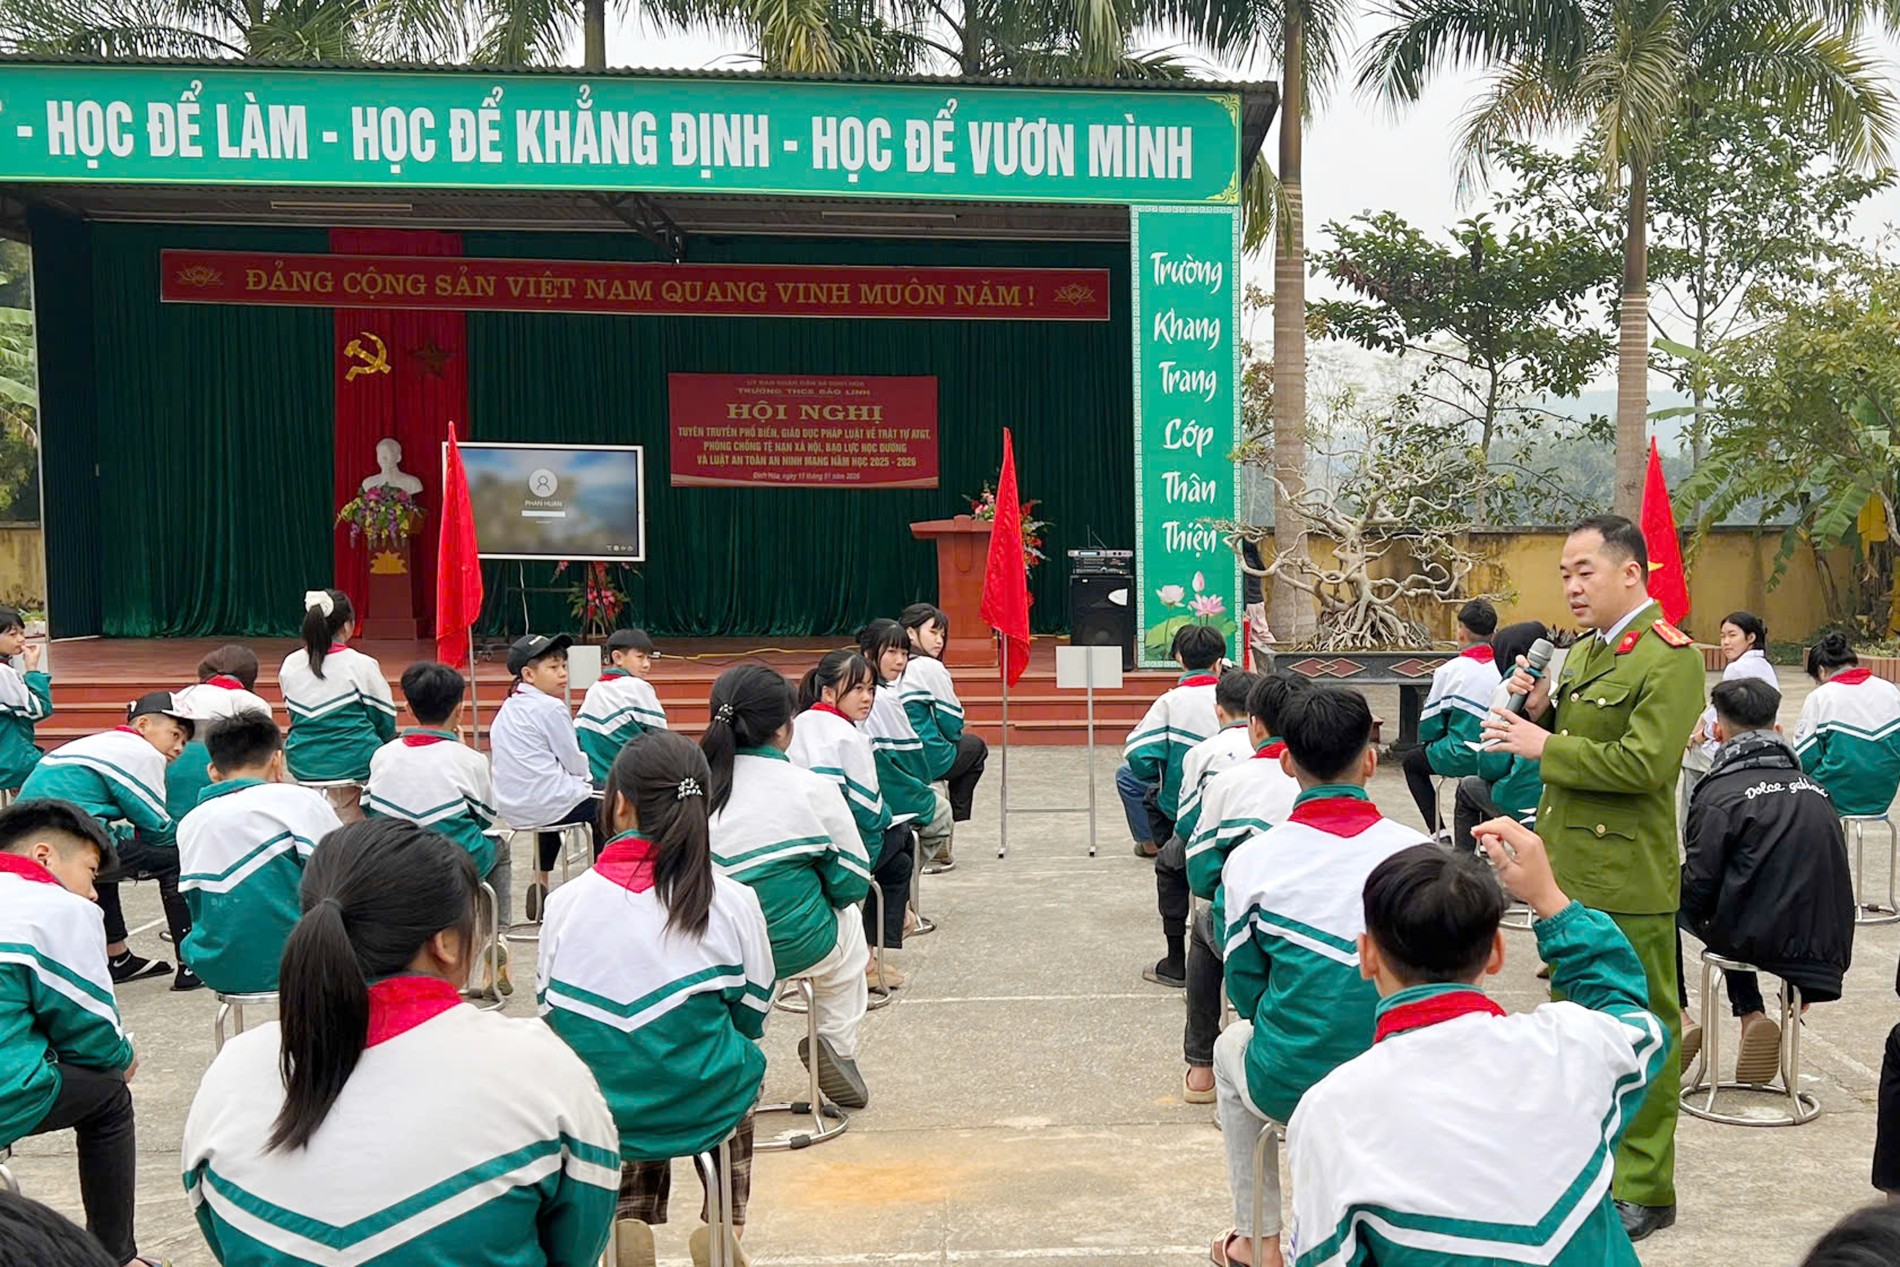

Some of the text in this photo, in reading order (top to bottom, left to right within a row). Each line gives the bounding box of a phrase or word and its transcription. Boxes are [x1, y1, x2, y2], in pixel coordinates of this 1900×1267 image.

[46, 100, 134, 168] HỌC
[147, 79, 203, 158] ĐỂ
[216, 92, 308, 160] LÀM
[351, 105, 436, 174] HỌC
[449, 86, 504, 162] ĐỂ
[516, 84, 658, 165] KHẲNG
[670, 111, 770, 178] ĐỊNH
[811, 116, 892, 182] HỌC
[904, 98, 956, 173] ĐỂ
[968, 117, 1075, 177] VƯƠN
[1088, 113, 1193, 179] MÌNH
[246, 260, 334, 293] ĐẢNG
[342, 266, 427, 299] CỘNG
[435, 266, 496, 297] SẢN
[507, 270, 576, 304] VIỆT
[584, 279, 651, 301] NAM
[661, 281, 767, 303] QUANG
[775, 283, 850, 304] VINH
[859, 278, 946, 306] MUÔN
[1150, 251, 1223, 294] Trường
[1153, 307, 1221, 350] Khang
[786, 387, 815, 395] THCS
[845, 388, 871, 396] LINH
[1158, 361, 1217, 402] Trang
[727, 400, 884, 425] HỘI NGHỊ
[1163, 418, 1214, 458] Lớp
[870, 457, 890, 467] 2025
[897, 457, 917, 467] 2026
[1161, 470, 1217, 504] Thân
[1162, 519, 1217, 558] Thiện
[1745, 782, 1785, 799] Dolce
